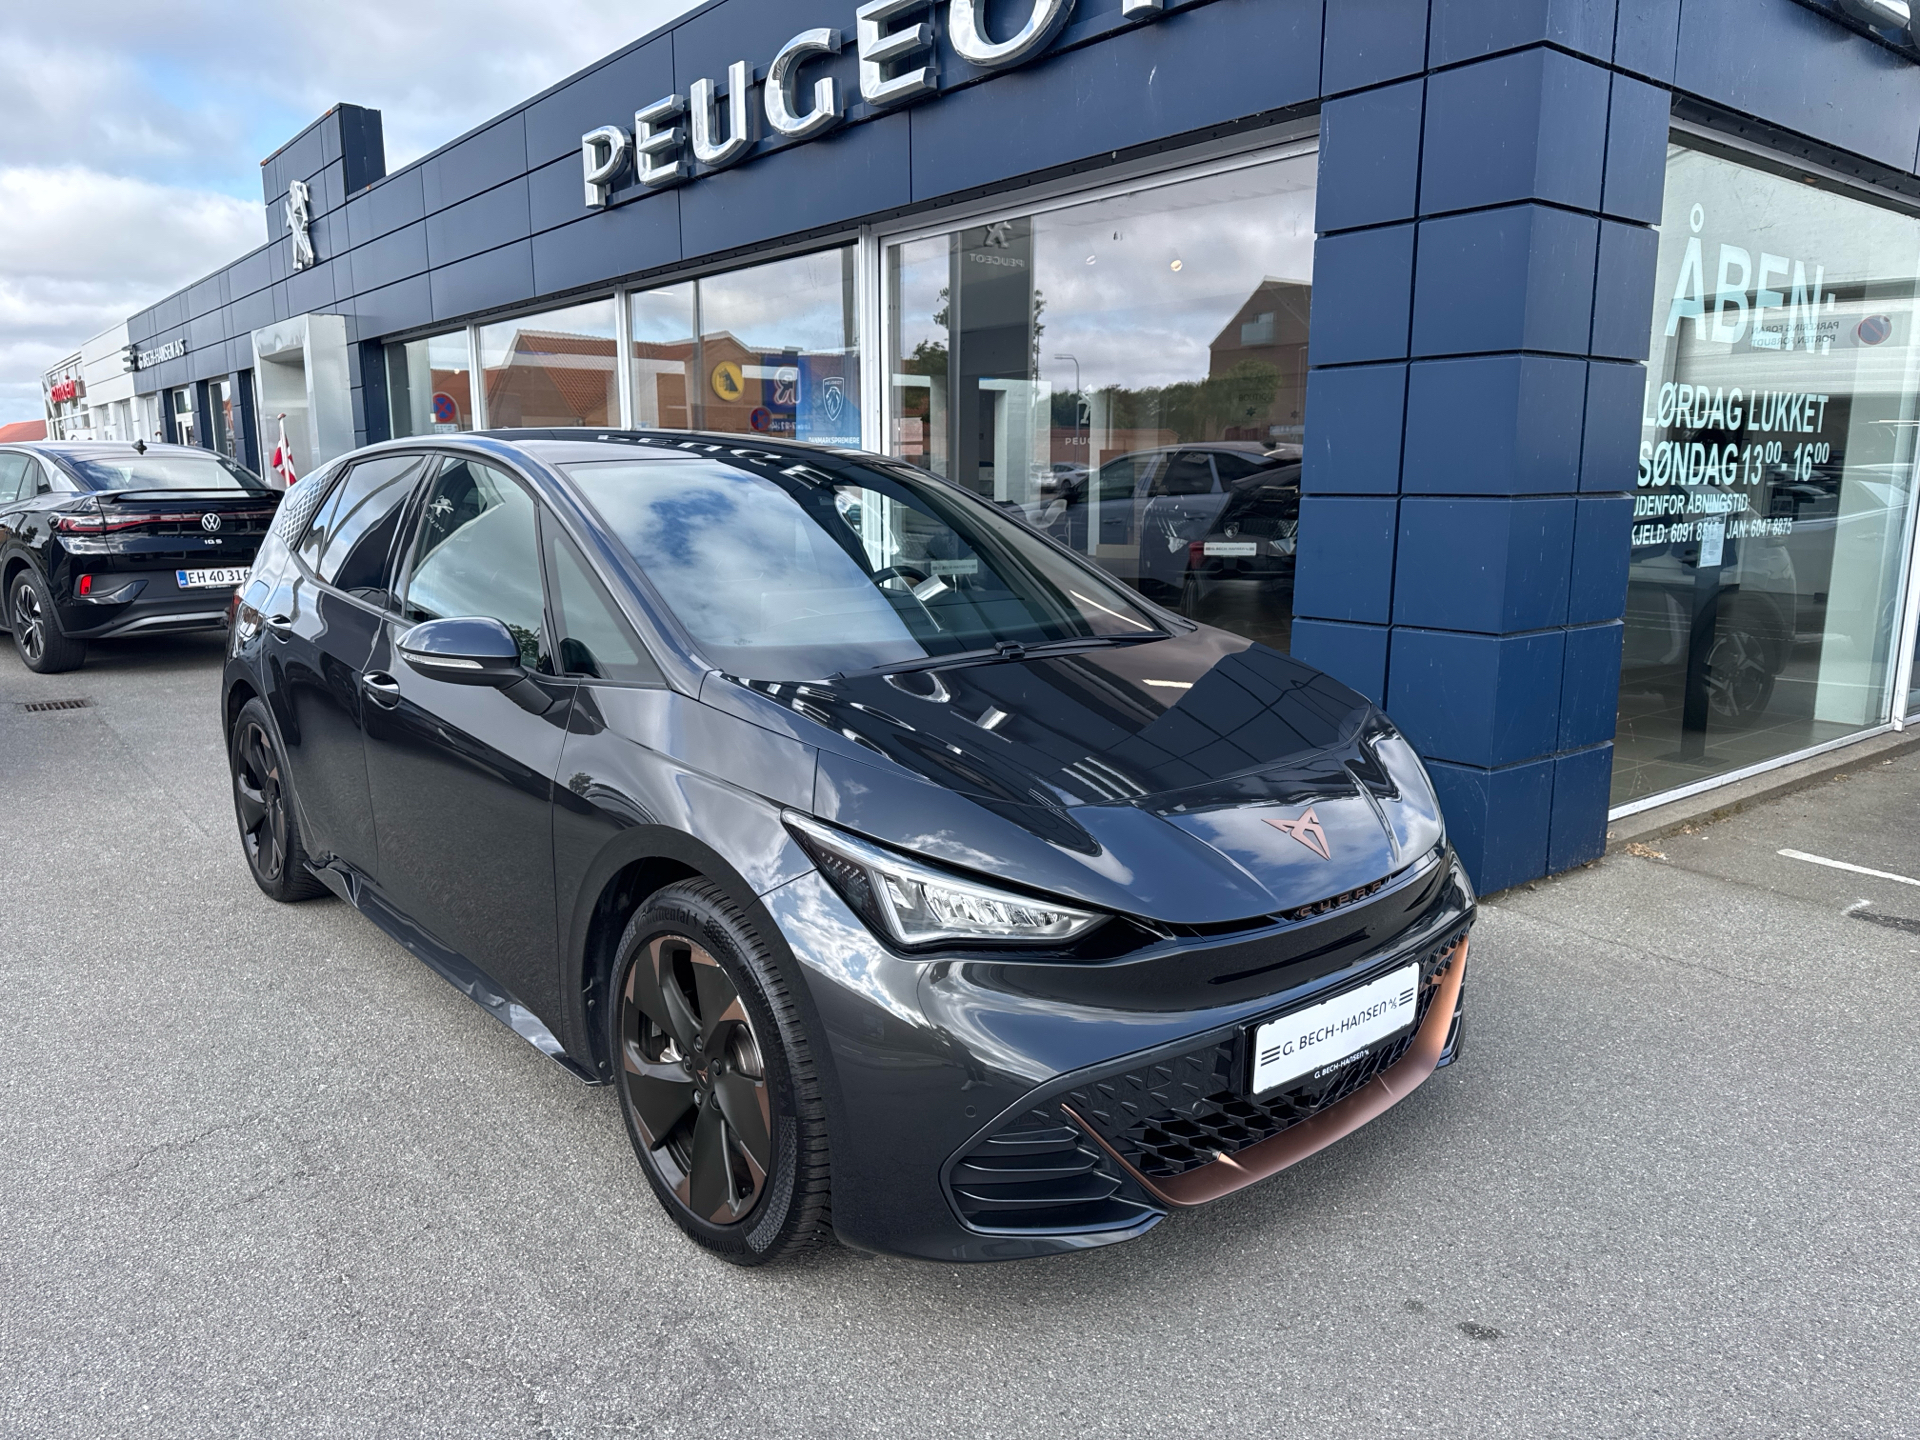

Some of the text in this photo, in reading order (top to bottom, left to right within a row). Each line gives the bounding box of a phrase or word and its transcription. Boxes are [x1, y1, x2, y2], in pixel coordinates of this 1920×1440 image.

[582, 0, 1163, 209] PEUGEO
[1641, 380, 1830, 433] LØRDAG LUKKET
[1637, 440, 1739, 487] SØNDAG
[1670, 522, 1694, 543] 6091
[1726, 519, 1749, 539] JAN:
[1750, 518, 1772, 538] 6047
[1772, 517, 1793, 536] 8875
[188, 569, 249, 584] EH 40 316
[1299, 1001, 1388, 1050] BECH-HANSEN
